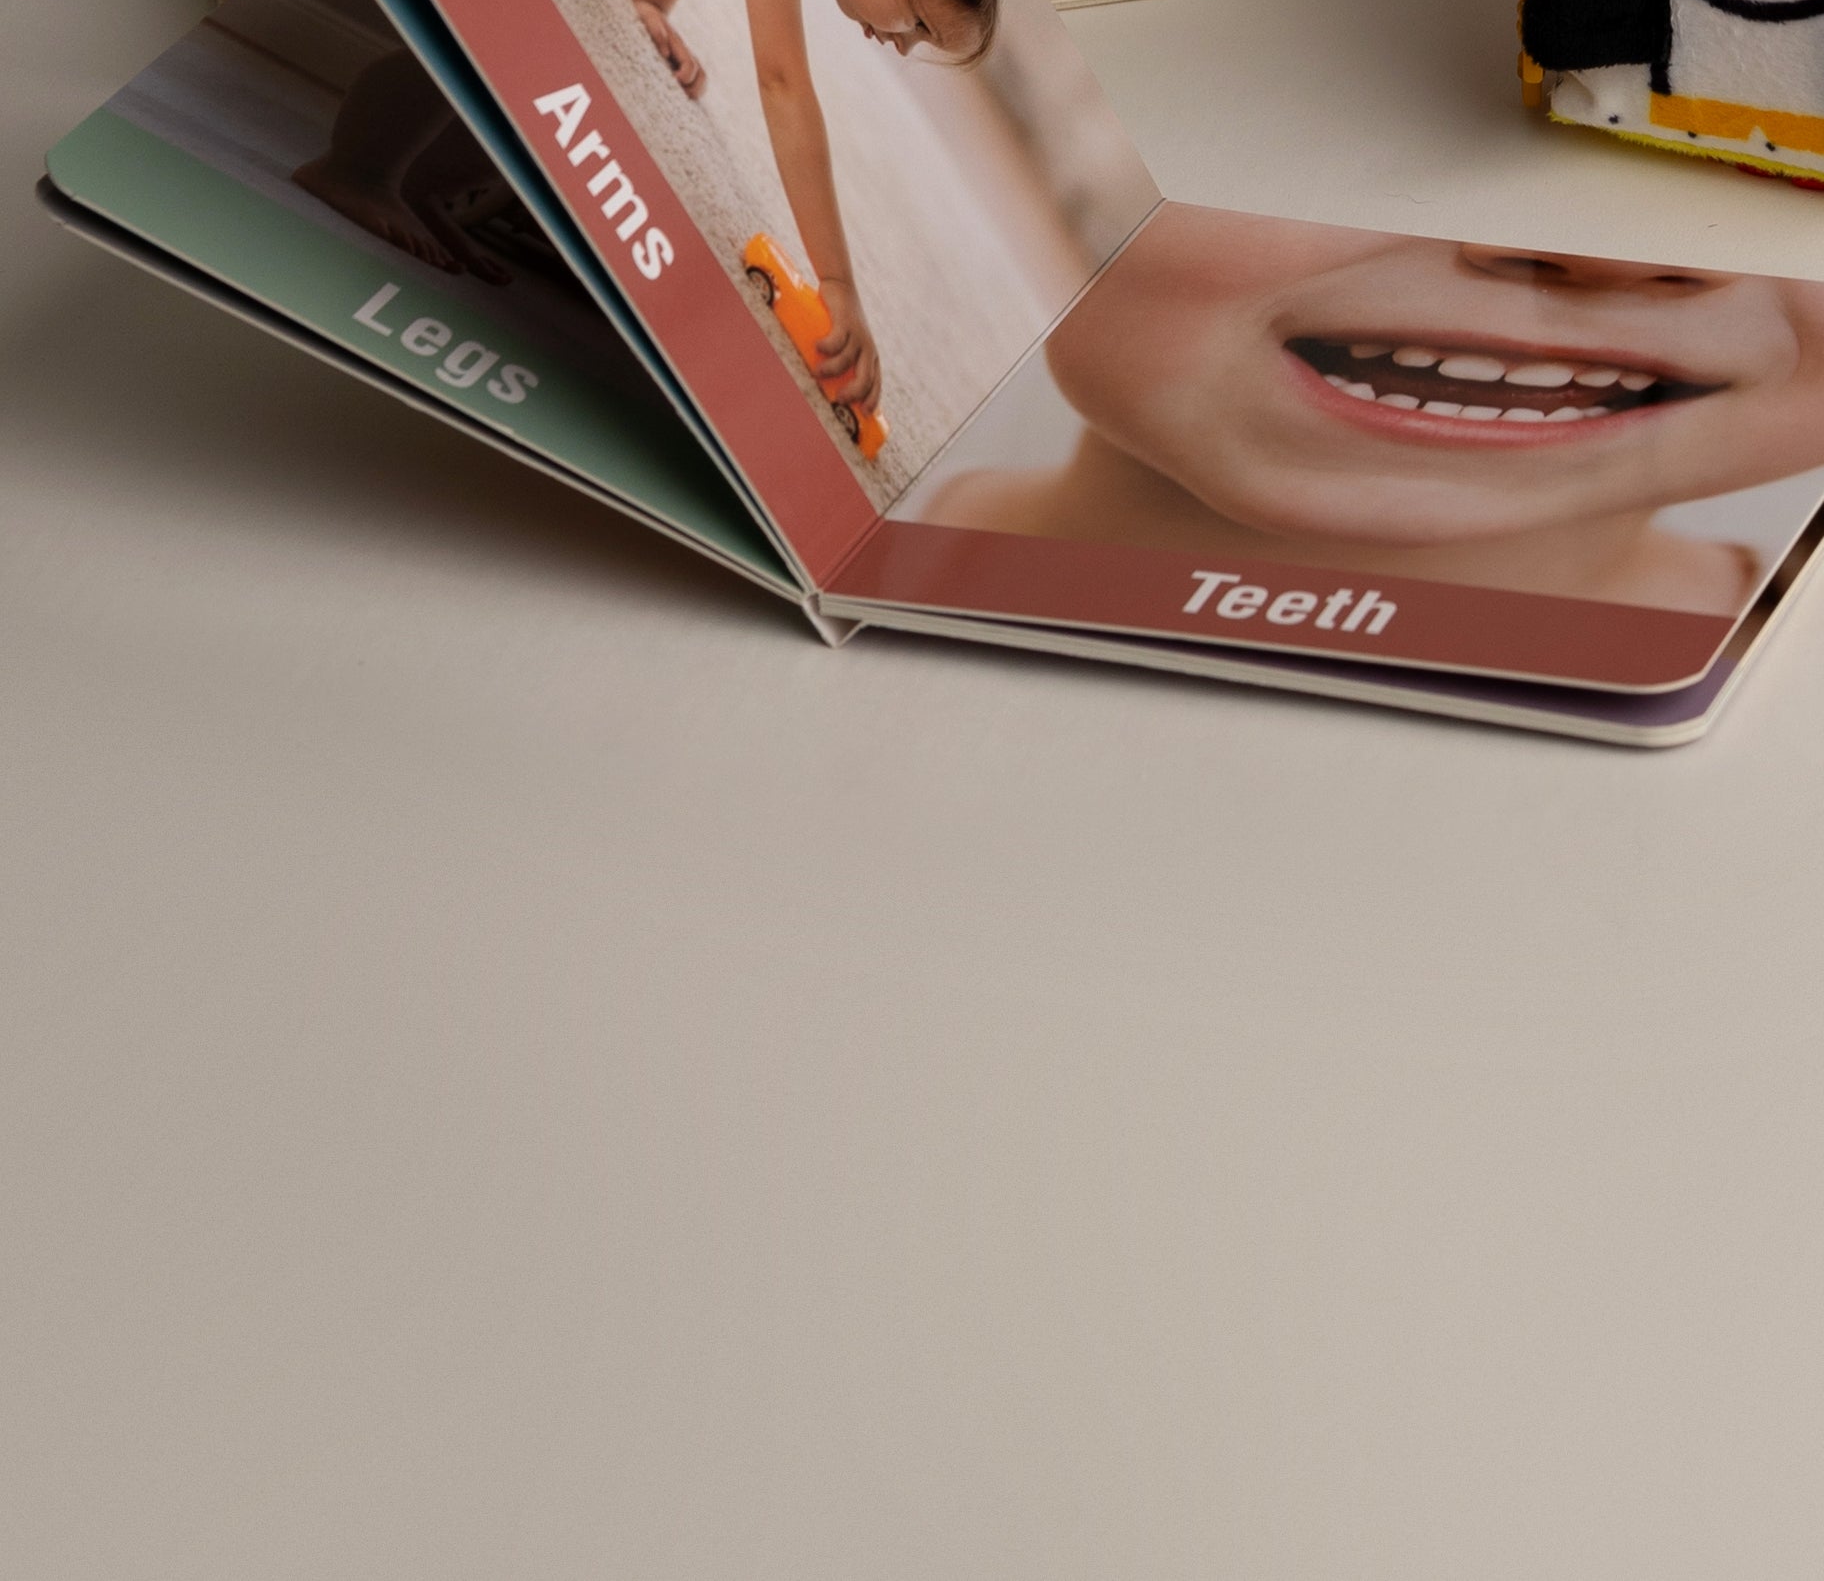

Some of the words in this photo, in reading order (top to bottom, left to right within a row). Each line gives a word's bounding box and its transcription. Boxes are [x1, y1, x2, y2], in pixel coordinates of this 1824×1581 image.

[533, 83, 675, 282] Arms
[352, 283, 540, 406] Legs
[1181, 570, 1398, 636] Teeth
